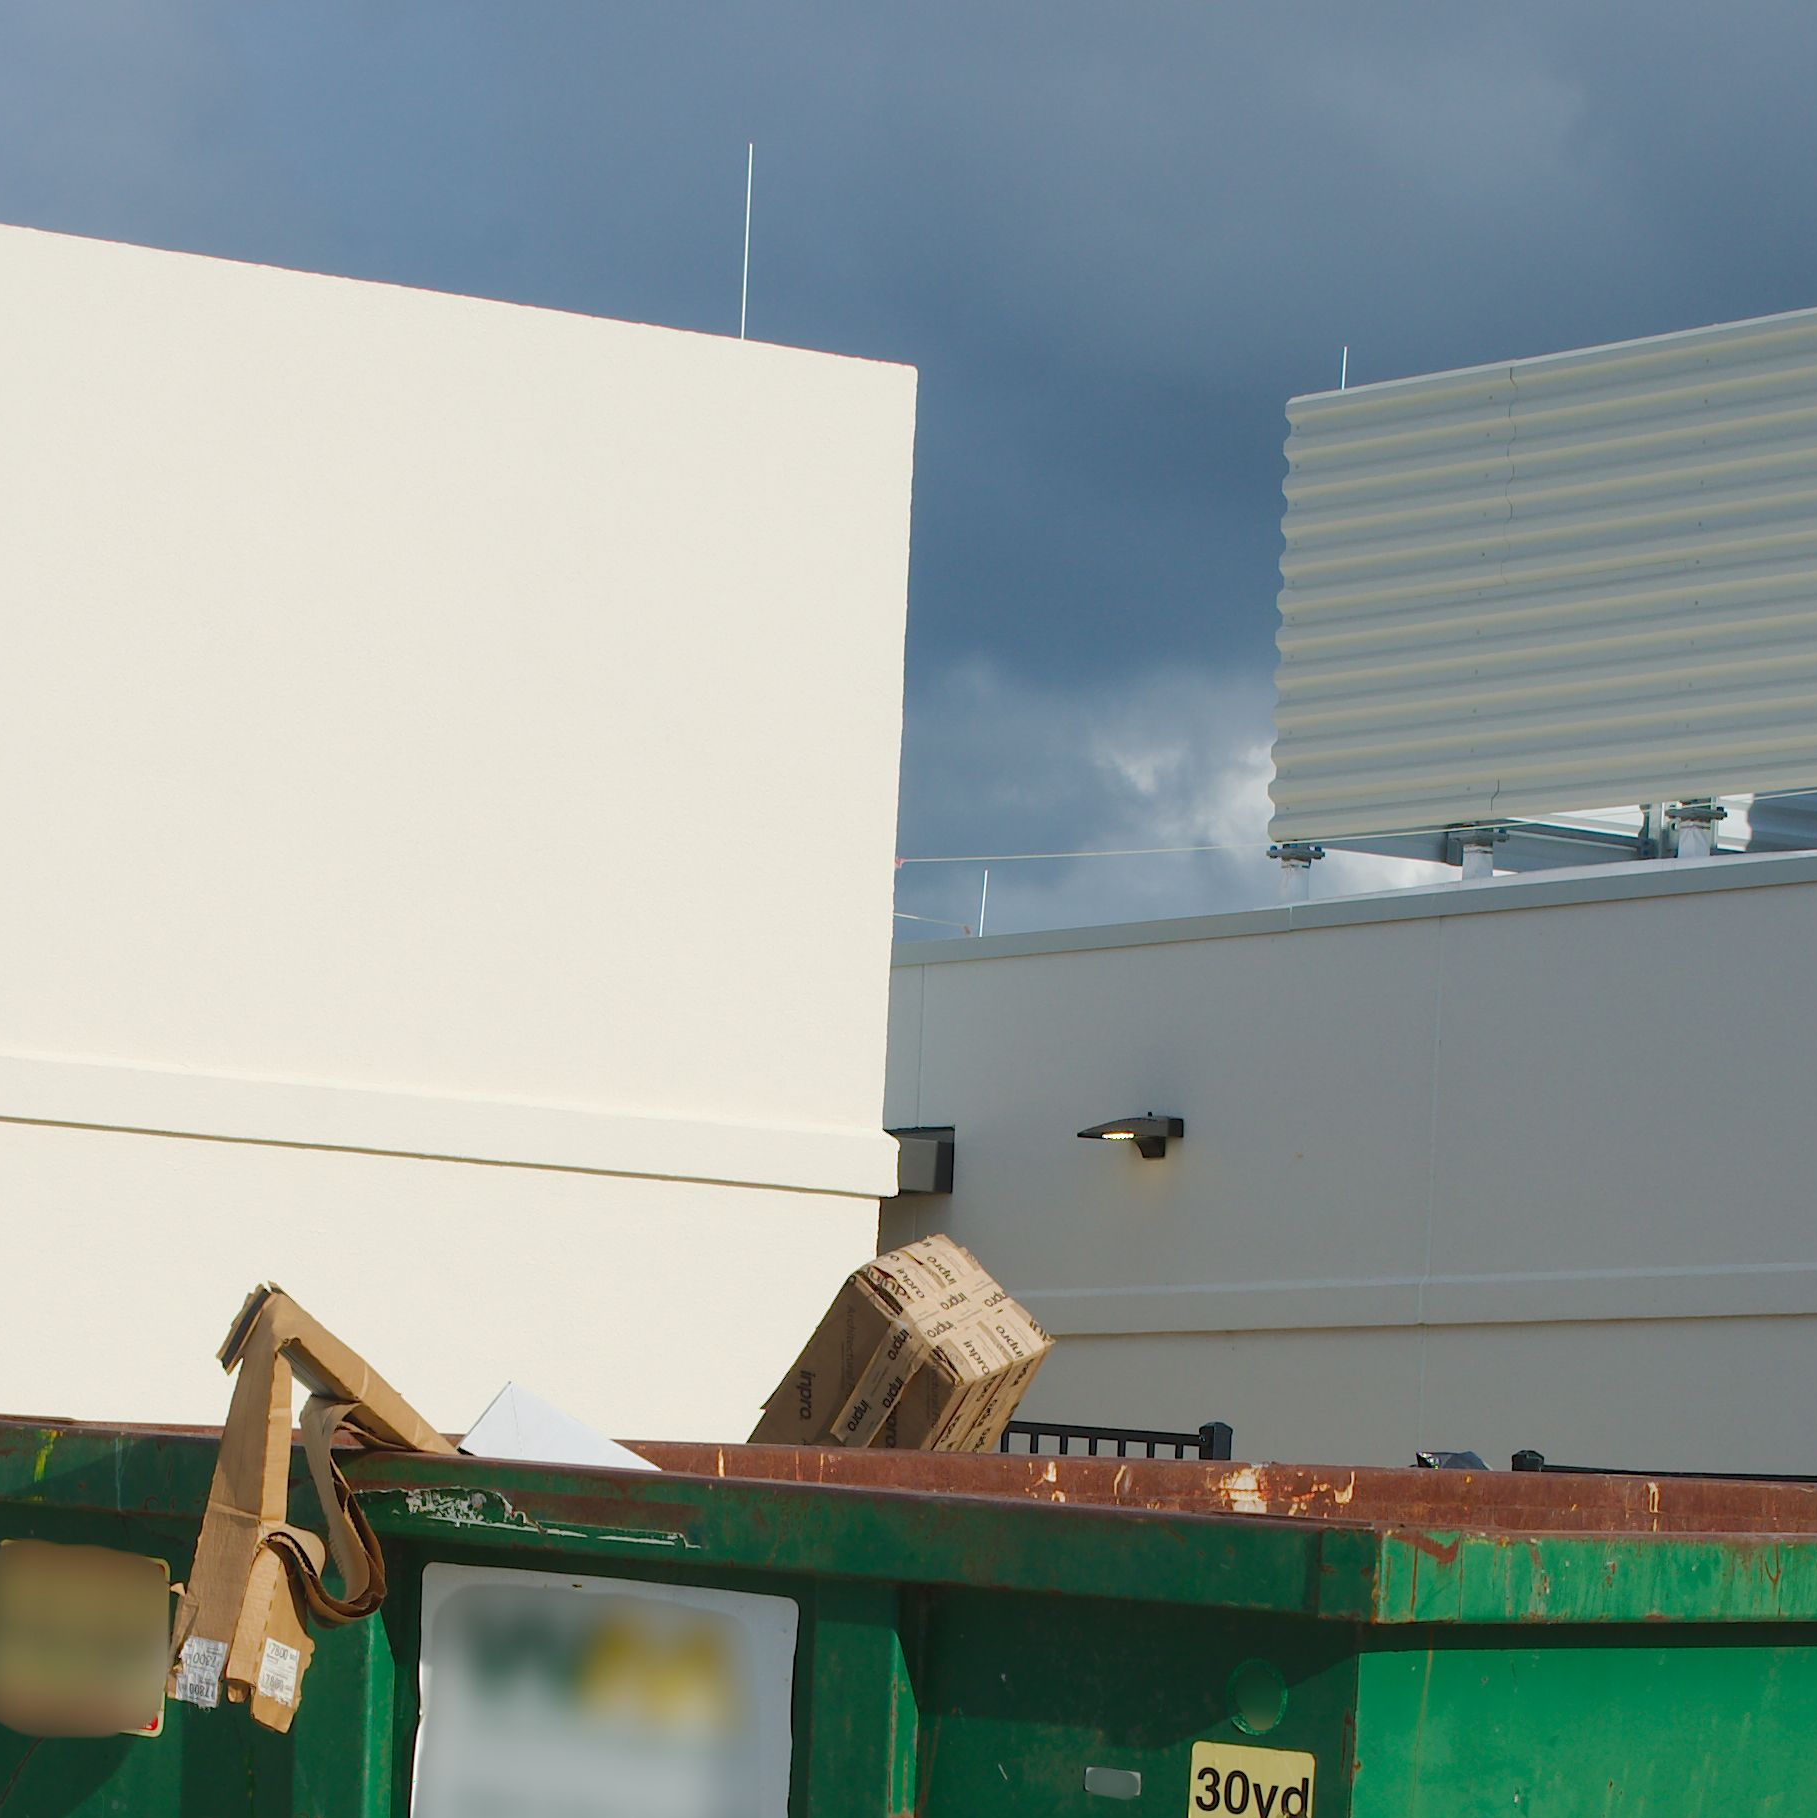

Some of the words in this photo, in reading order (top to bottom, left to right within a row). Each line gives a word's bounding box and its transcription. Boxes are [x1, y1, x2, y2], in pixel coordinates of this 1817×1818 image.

[983, 1291, 1007, 1308] npro
[887, 1328, 912, 1361] inpro
[797, 1370, 816, 1420] inpro
